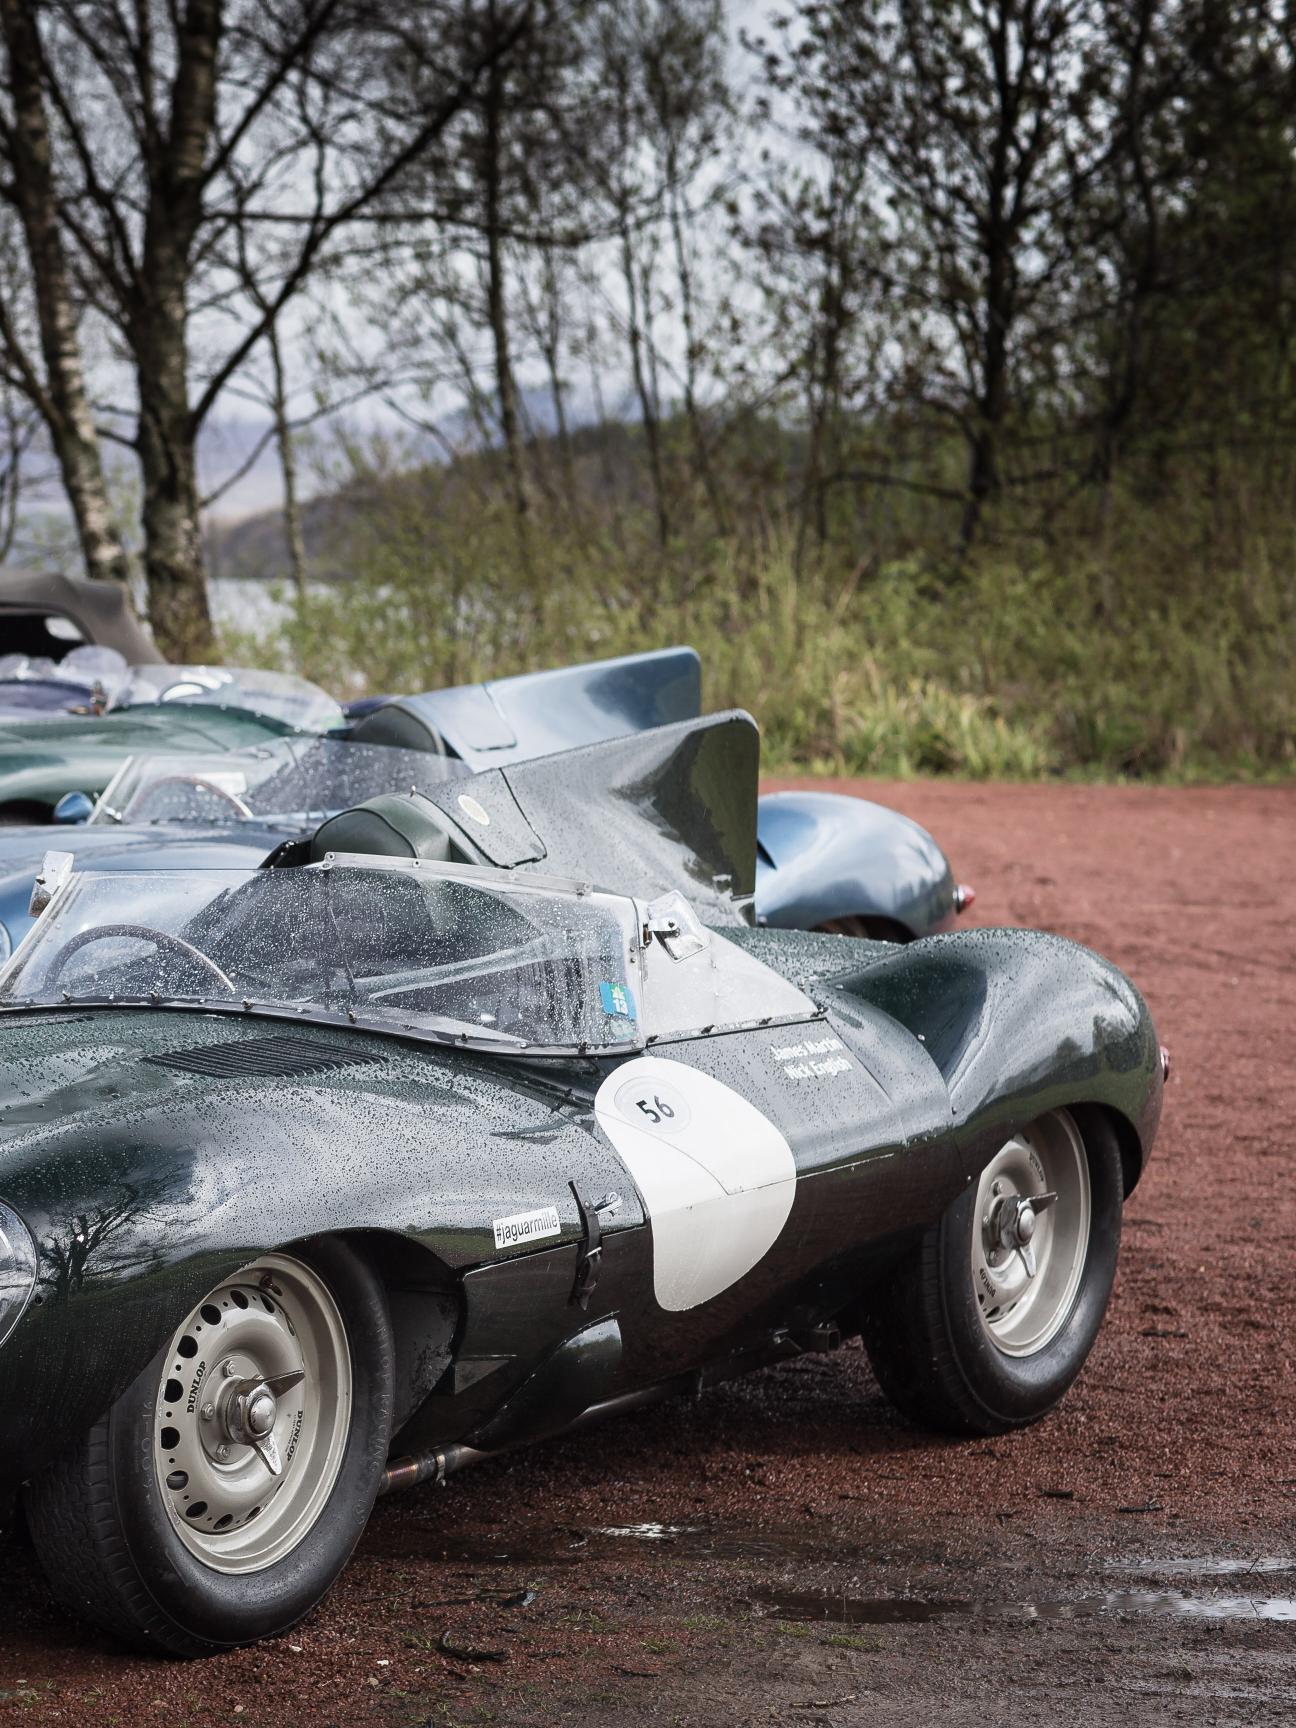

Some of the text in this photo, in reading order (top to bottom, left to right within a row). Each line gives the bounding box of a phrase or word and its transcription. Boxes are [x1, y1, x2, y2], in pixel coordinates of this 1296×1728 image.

[770, 1037, 843, 1061] James Martin
[784, 1056, 853, 1080] Nick English
[635, 1095, 675, 1124] 56
[496, 1211, 558, 1245] #jaguarmille
[187, 1361, 206, 1413] DUNLOP
[287, 1410, 303, 1461] DUNLOP
